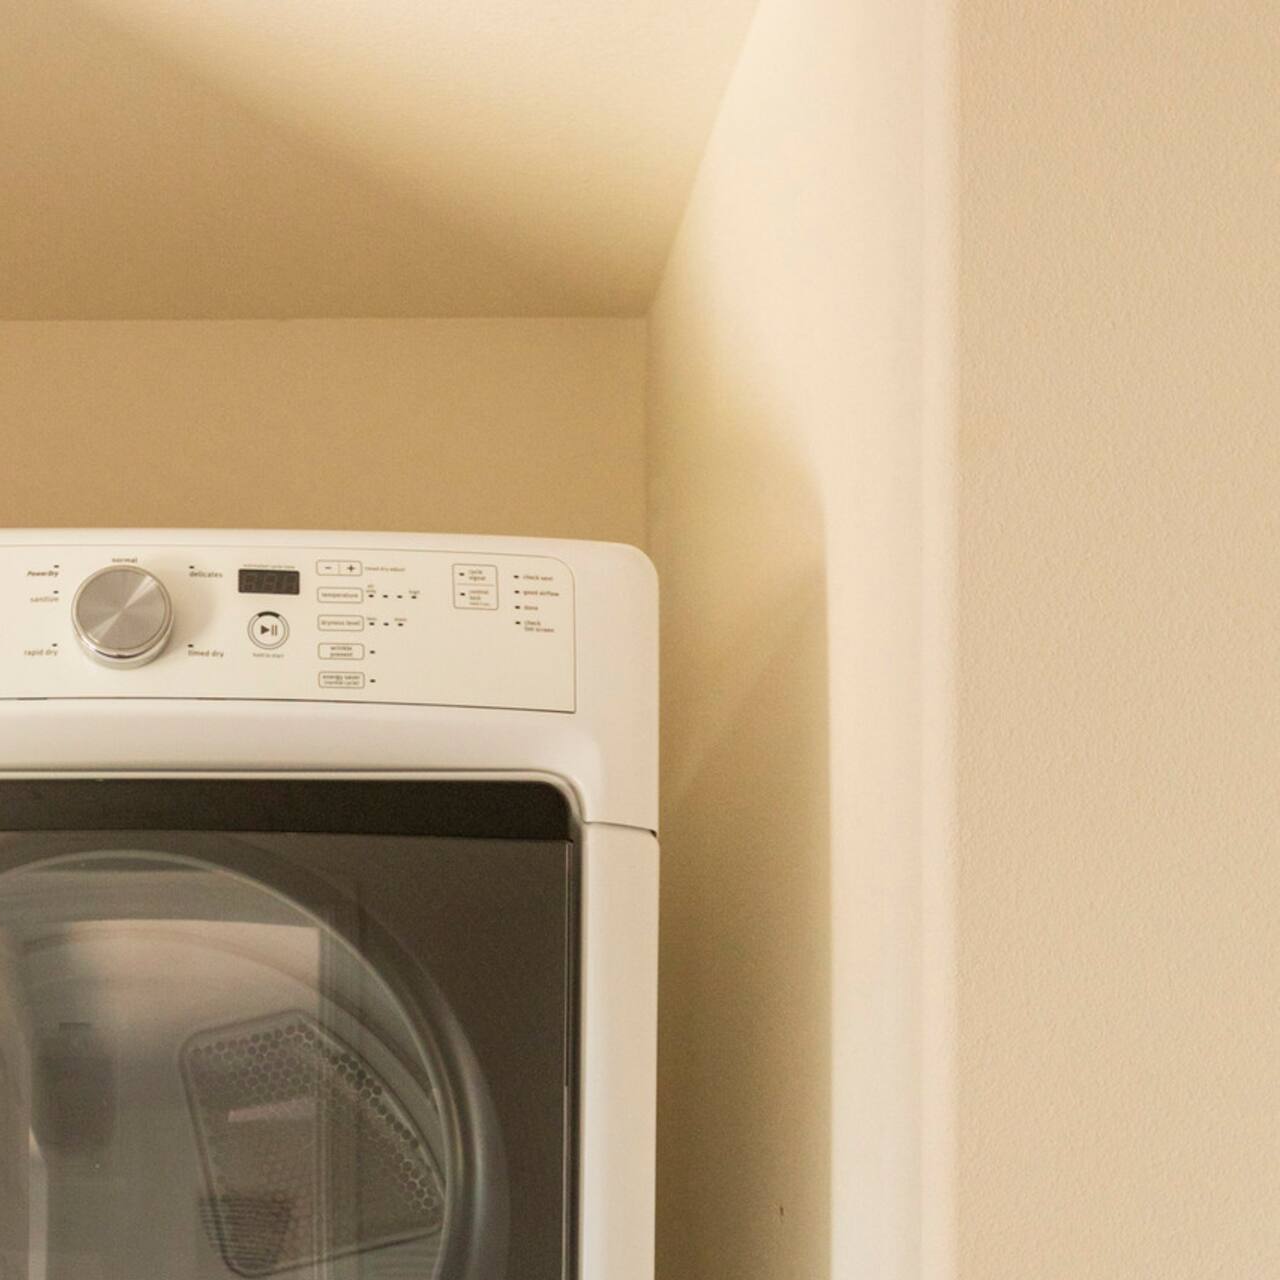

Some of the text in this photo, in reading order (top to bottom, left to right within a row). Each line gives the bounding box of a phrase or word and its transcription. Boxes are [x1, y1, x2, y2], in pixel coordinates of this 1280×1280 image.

[24, 648, 58, 656] rapid dry
[212, 650, 224, 658] dry
